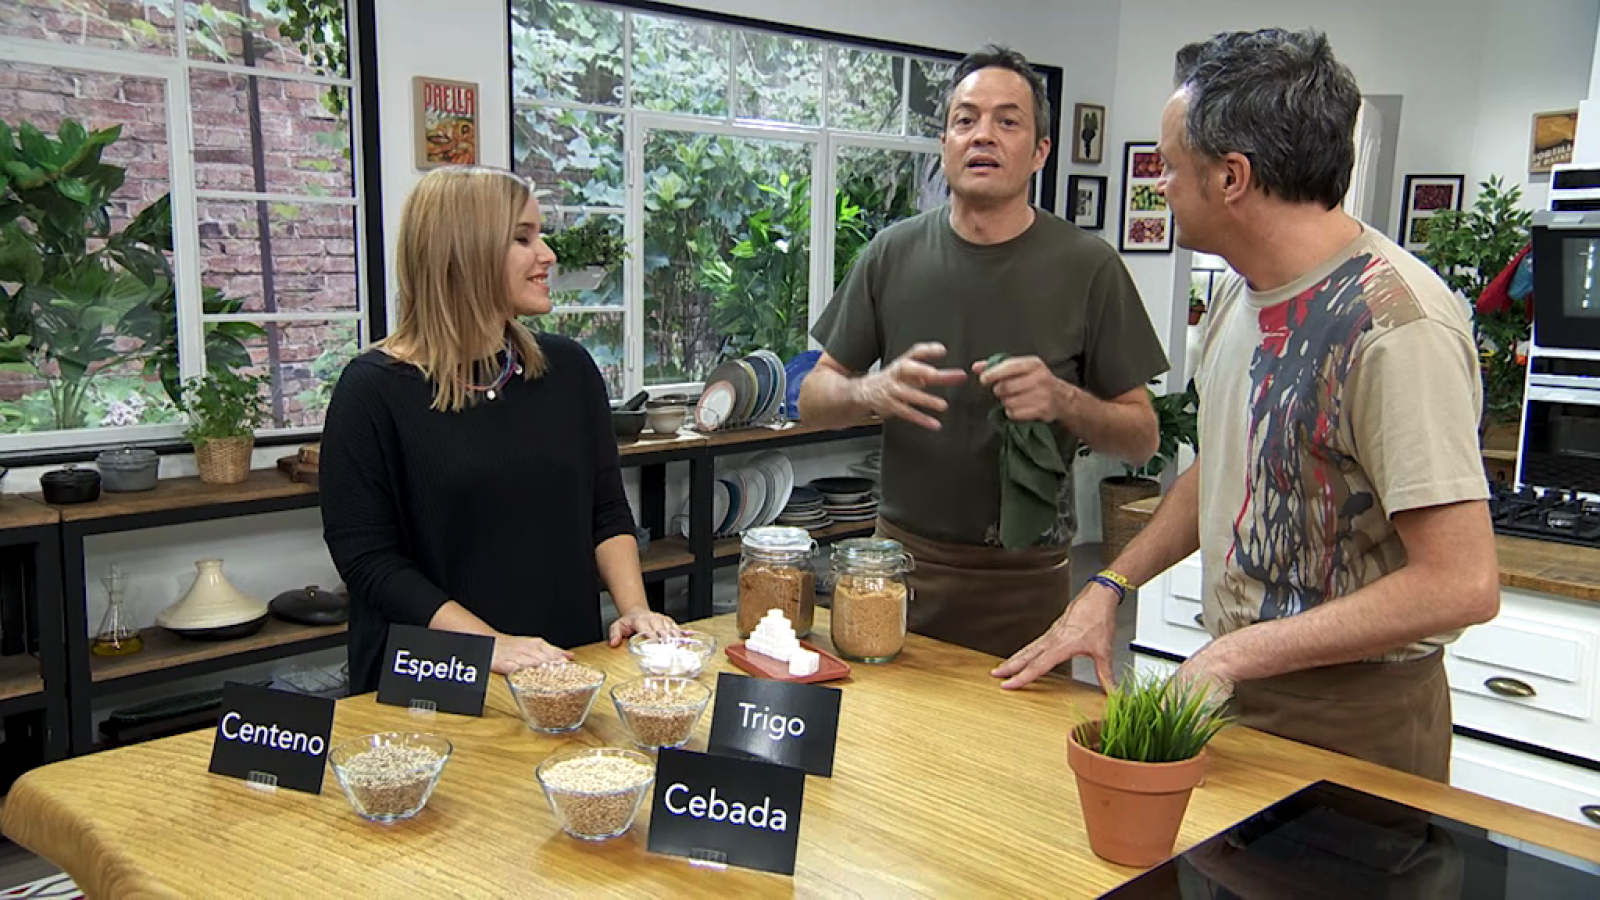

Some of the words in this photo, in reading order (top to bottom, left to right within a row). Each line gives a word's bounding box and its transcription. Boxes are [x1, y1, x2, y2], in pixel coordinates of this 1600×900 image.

[394, 649, 477, 683] Espelta
[221, 712, 324, 755] Centeno
[738, 702, 806, 740] Trigo
[665, 783, 787, 831] Cebada
